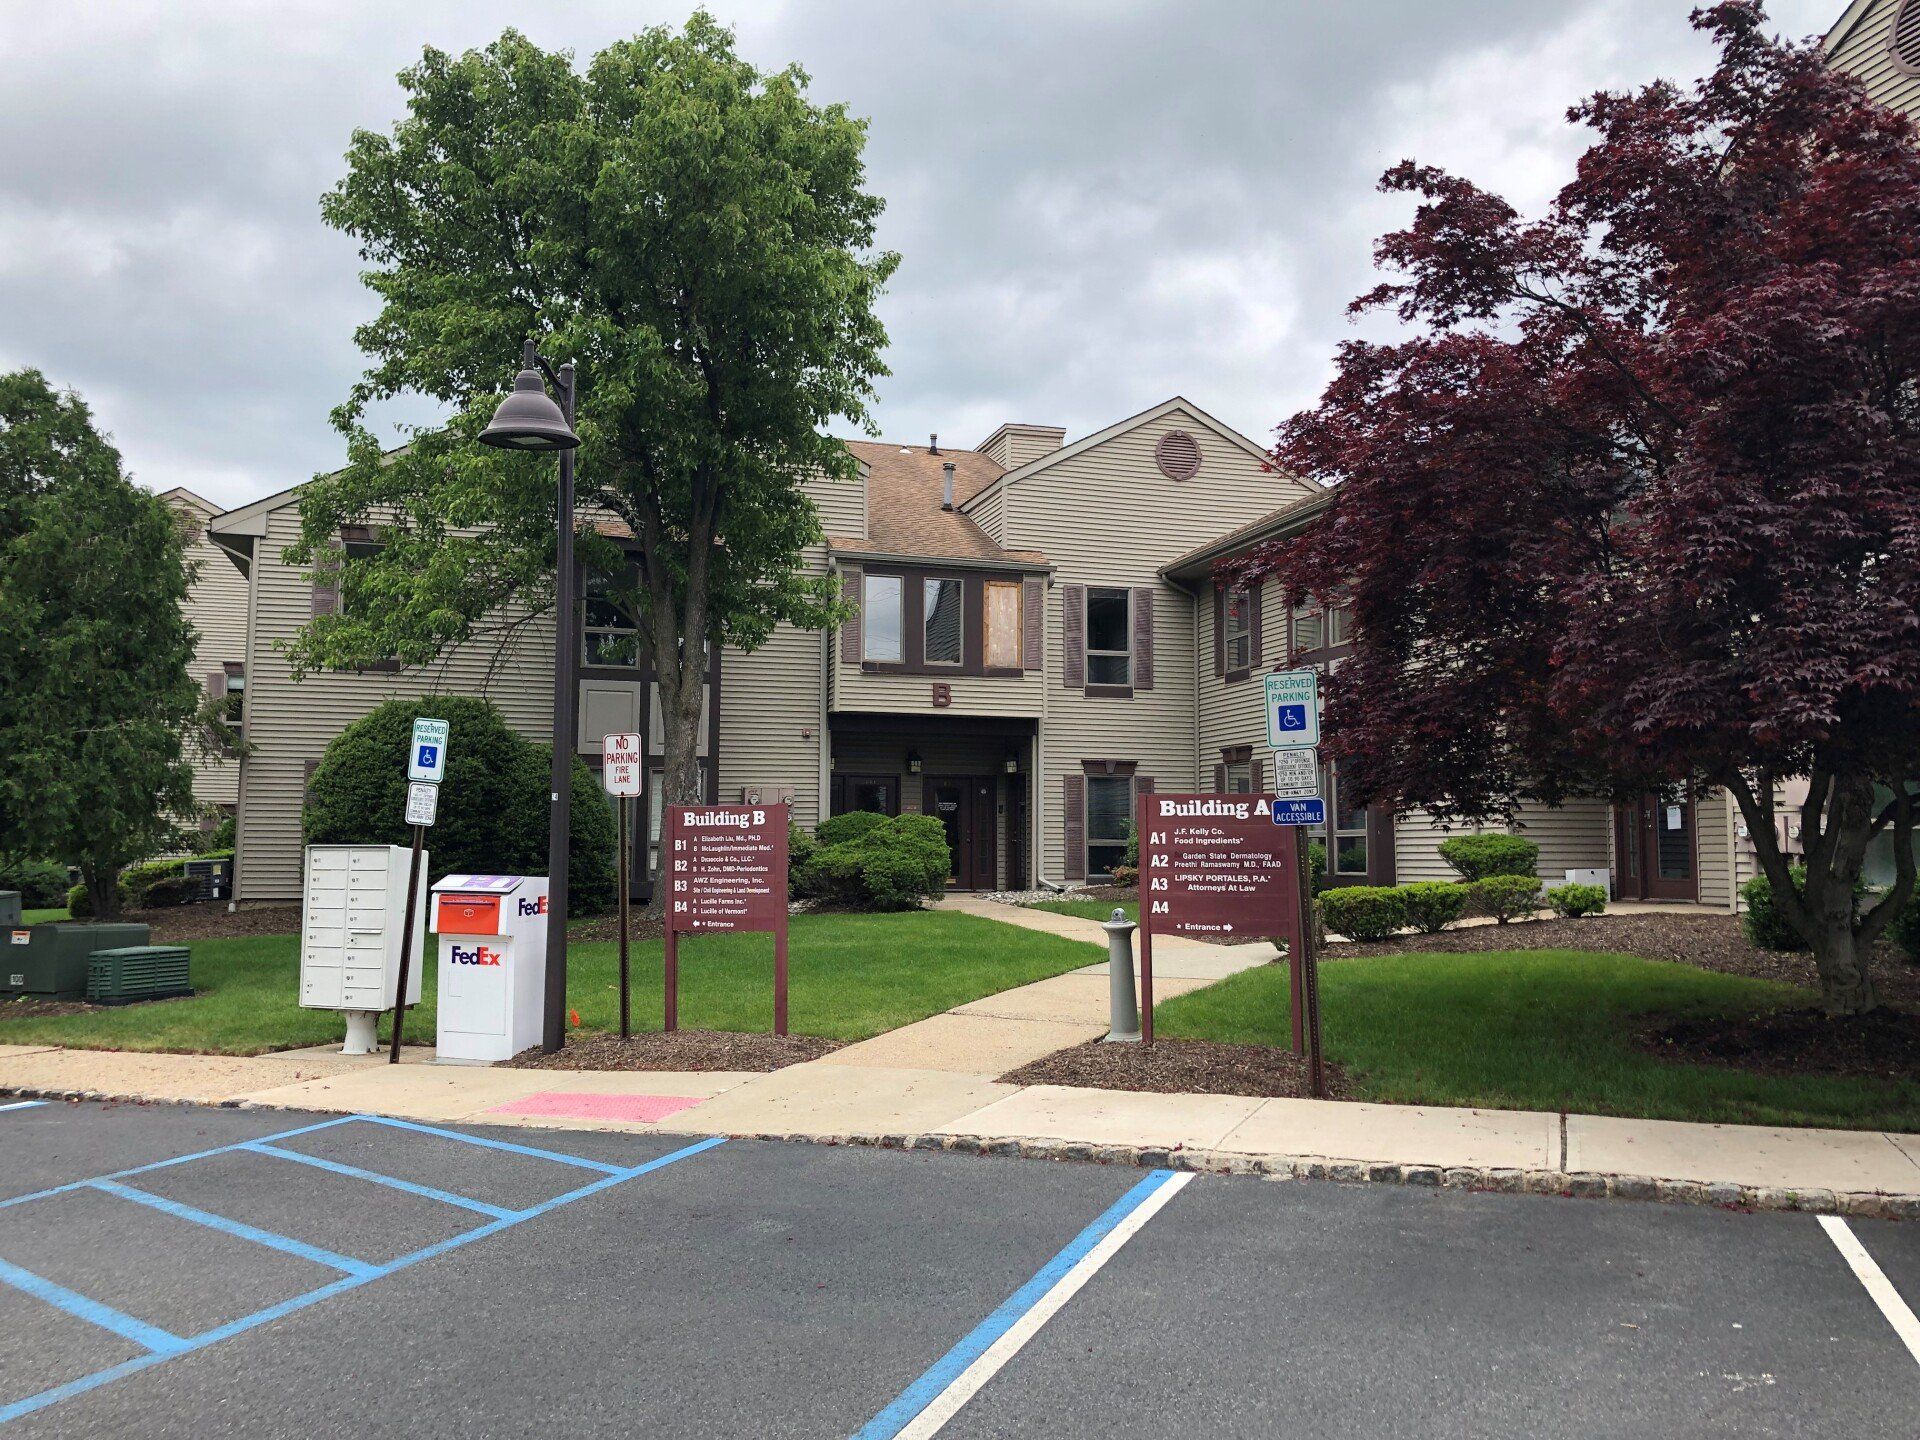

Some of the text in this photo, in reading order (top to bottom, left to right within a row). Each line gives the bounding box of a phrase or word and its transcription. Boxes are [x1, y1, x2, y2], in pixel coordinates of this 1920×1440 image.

[1268, 679, 1312, 690] RESERVED
[932, 682, 951, 707] B
[1272, 692, 1310, 702] PARKING
[416, 724, 446, 734] RESERVED
[417, 734, 443, 745] PARKING
[616, 738, 629, 750] NO
[606, 752, 638, 764] PARKING
[615, 766, 629, 774] FIRE
[614, 775, 631, 783] LANE
[1160, 799, 1271, 819] Building A
[1289, 803, 1306, 811] VAN
[683, 810, 766, 828] Building B
[1276, 812, 1321, 821] ACCESSIBLE
[1189, 828, 1209, 836] Kelly
[1150, 832, 1166, 844] A1
[674, 840, 687, 851] B1
[1151, 855, 1169, 867] A2
[1230, 852, 1272, 860] Dermatology
[674, 860, 688, 871] B2
[709, 877, 751, 885] Engineering,
[1150, 878, 1168, 890] A3
[1205, 875, 1251, 883] PORTALES,
[674, 880, 688, 891] B3
[1187, 884, 1226, 892] Attorneys
[518, 896, 549, 916] FedE
[674, 901, 688, 912] B4
[1151, 901, 1169, 913] A4
[1184, 923, 1221, 931] Entrance
[451, 946, 500, 966] FedEx
